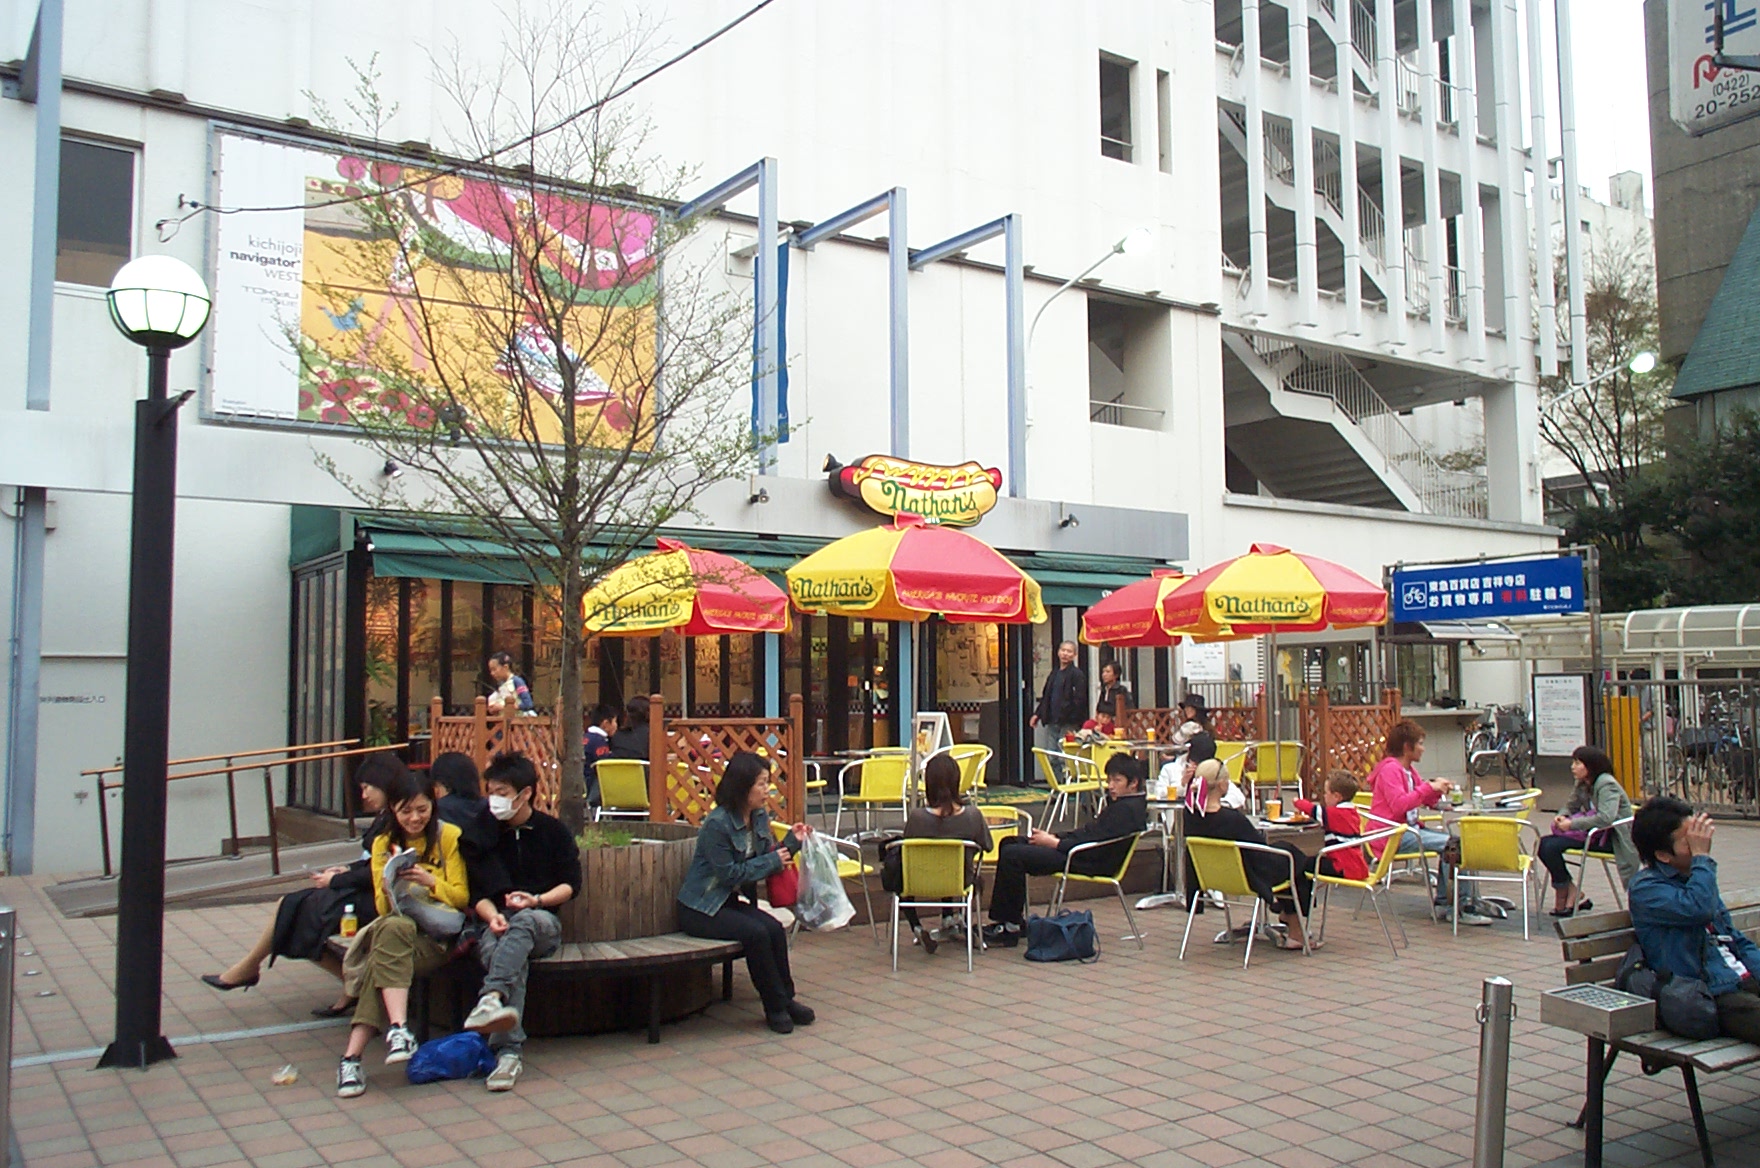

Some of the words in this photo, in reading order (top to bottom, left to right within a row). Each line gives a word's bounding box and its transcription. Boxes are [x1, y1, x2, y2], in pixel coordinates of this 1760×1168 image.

[1712, 74, 1750, 97] (0422)
[248, 234, 302, 257] kichijoji
[230, 251, 297, 267] navigator
[264, 268, 301, 282] WEST
[881, 479, 978, 517] Nathan's
[791, 575, 874, 599] Nathan's
[592, 598, 681, 622] Nathan's
[1214, 594, 1310, 614] Nathan's
